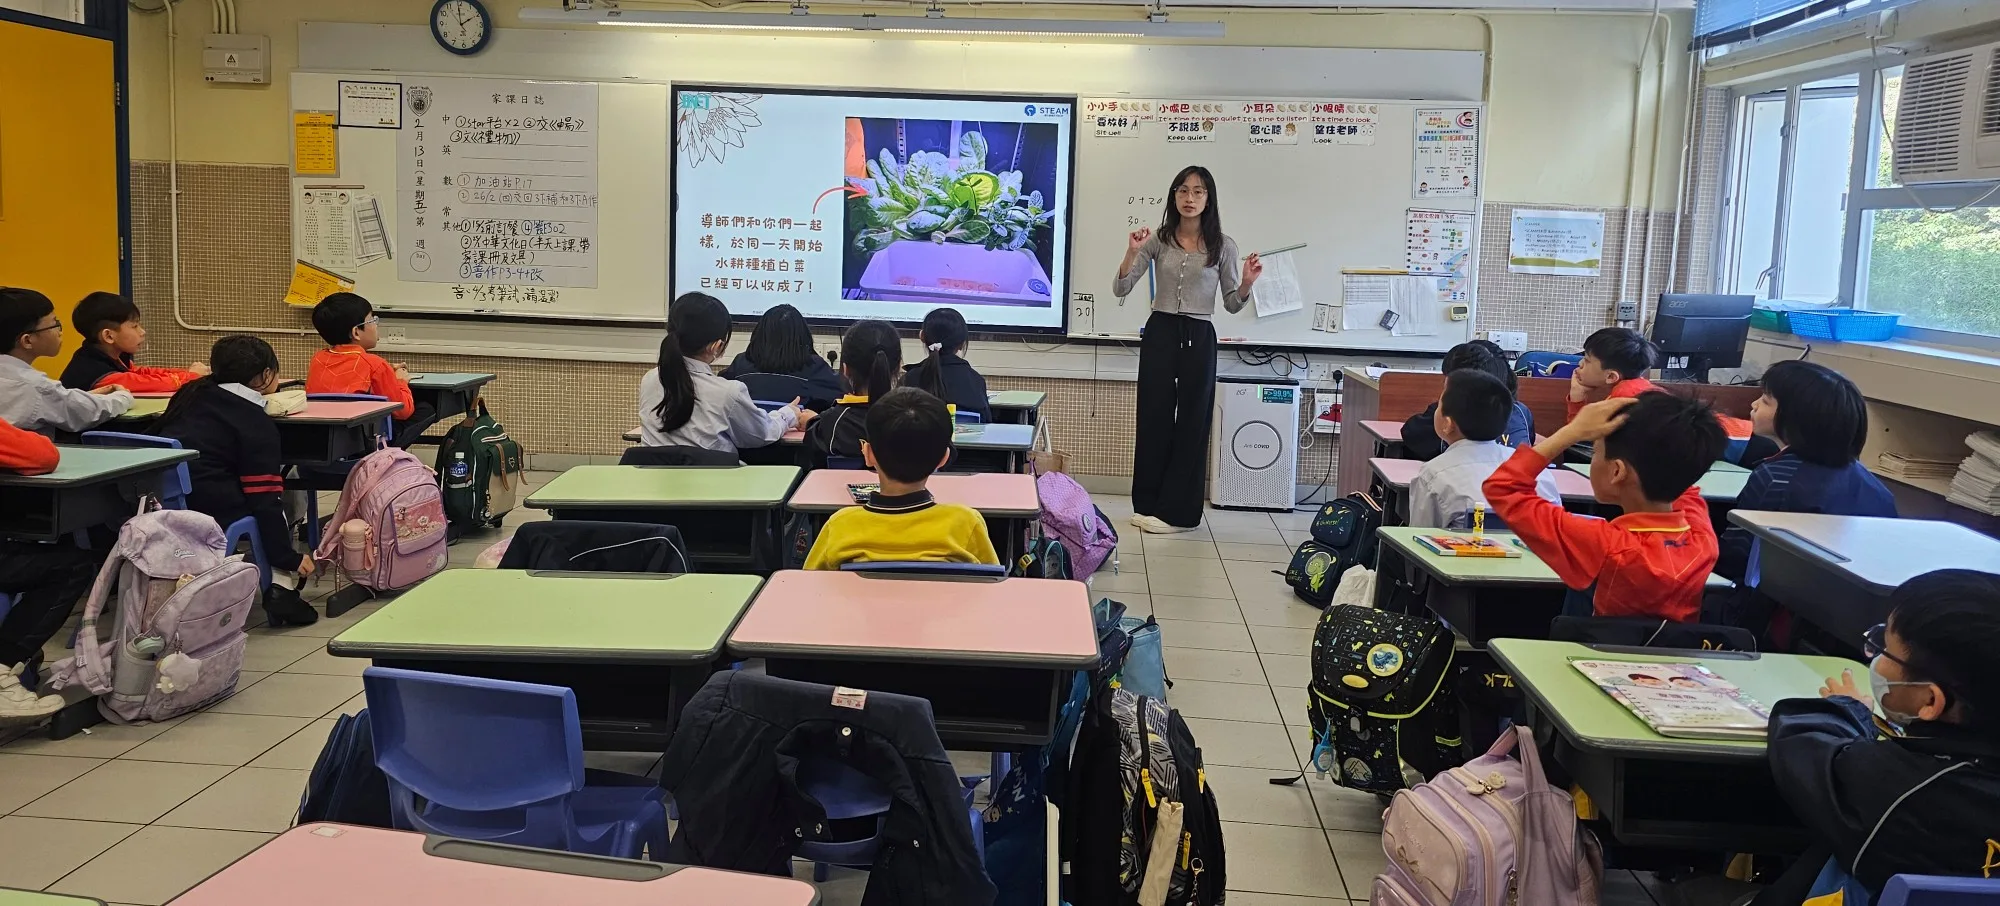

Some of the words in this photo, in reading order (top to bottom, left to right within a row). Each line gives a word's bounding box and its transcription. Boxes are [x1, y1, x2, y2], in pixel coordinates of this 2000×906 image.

[491, 93, 545, 106] 家課日誌
[1039, 107, 1069, 115] STEAM
[1087, 101, 1118, 112] 小小手
[1158, 103, 1190, 113] 小嘴巴
[1243, 103, 1275, 113] 小耳朵
[442, 114, 450, 125] 中
[1168, 121, 1200, 132] 不說話
[1250, 124, 1282, 135] 留心聽
[1315, 124, 1358, 136] 望住老師
[442, 144, 451, 155] 英
[442, 175, 453, 187] 數
[442, 206, 451, 217] 常
[442, 221, 461, 232] 其他
[701, 212, 823, 232] 導師們和你們一起
[415, 239, 425, 249] 週
[715, 256, 805, 273] 水耕種植白菜
[1668, 300, 1688, 308] acer
